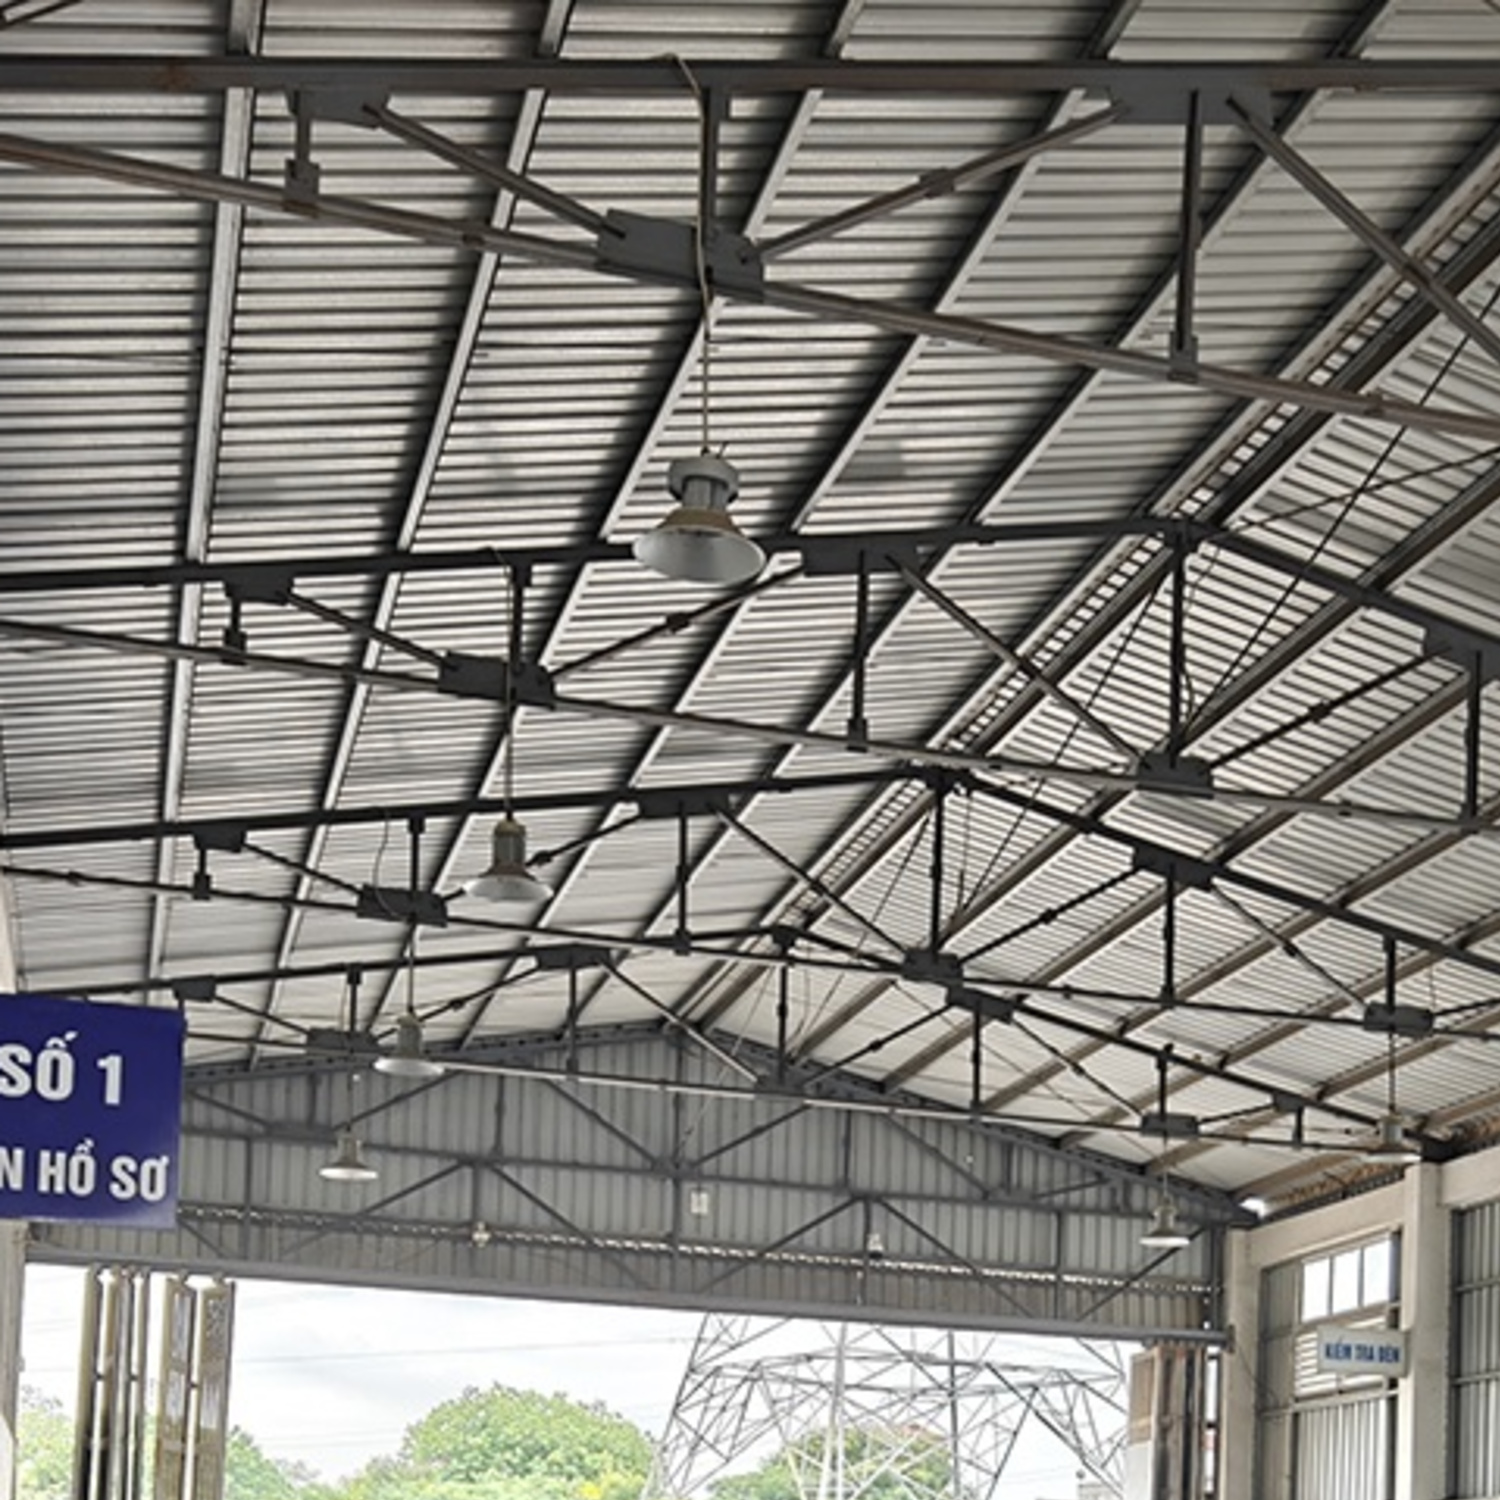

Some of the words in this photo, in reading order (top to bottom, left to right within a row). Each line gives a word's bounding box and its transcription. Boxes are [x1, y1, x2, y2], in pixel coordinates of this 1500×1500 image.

[0, 1031, 78, 1100] SỐ
[97, 1055, 122, 1105] 1
[38, 1138, 96, 1196] HỒ
[109, 1154, 170, 1200] SƠ
